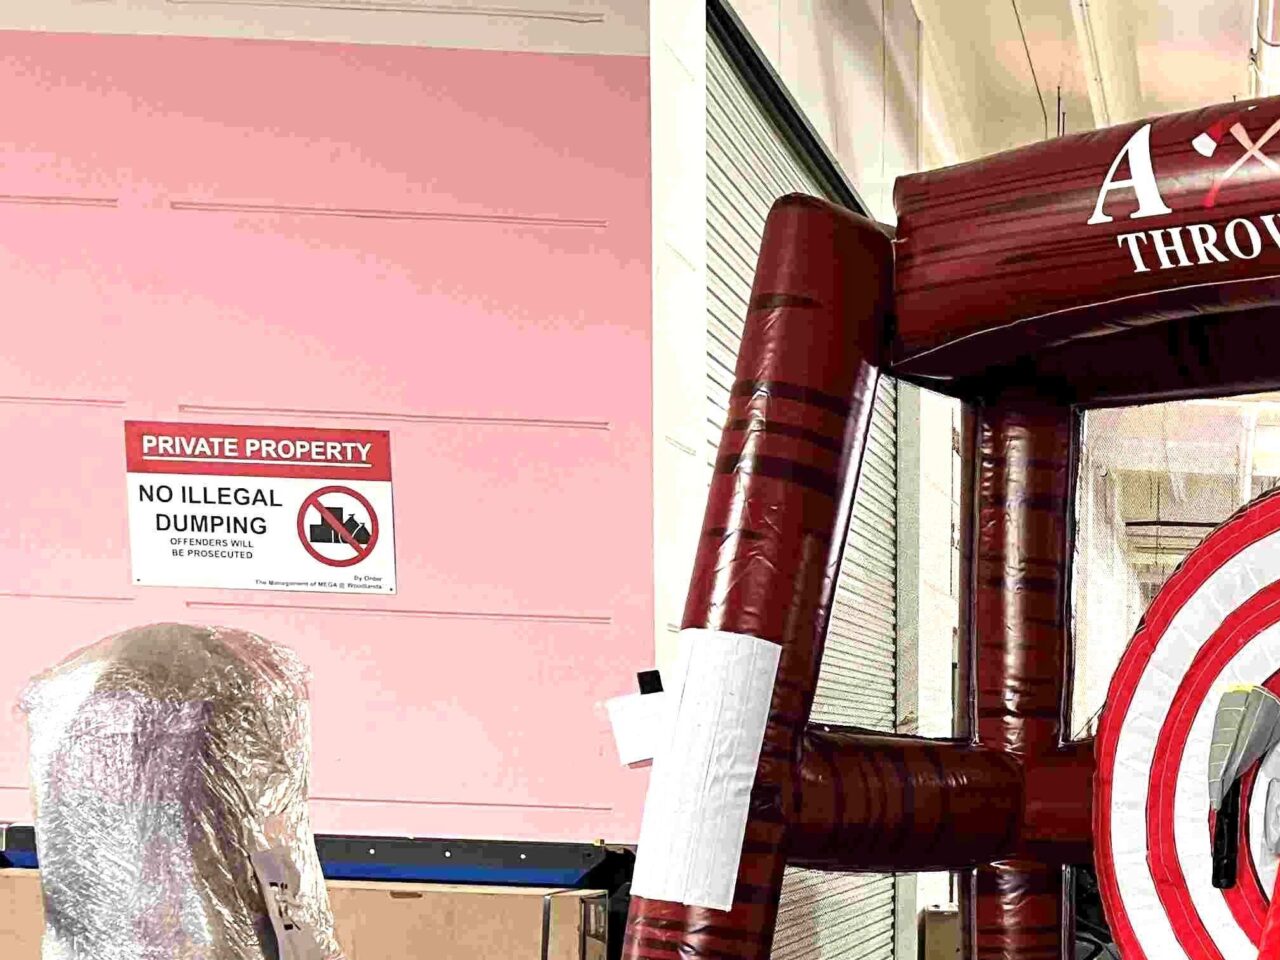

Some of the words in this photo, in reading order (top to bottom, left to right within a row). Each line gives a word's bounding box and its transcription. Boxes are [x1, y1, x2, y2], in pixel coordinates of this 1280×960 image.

[142, 434, 239, 457] PRIVATE
[245, 439, 372, 461] PROPERTY
[139, 484, 173, 503] NO
[182, 486, 283, 507] ILLEGAL
[156, 513, 267, 535] DUMPING
[170, 537, 228, 548] OFFENDERS
[231, 539, 254, 549] WILL
[172, 548, 184, 557] BE
[187, 549, 253, 559] PROSECUTED
